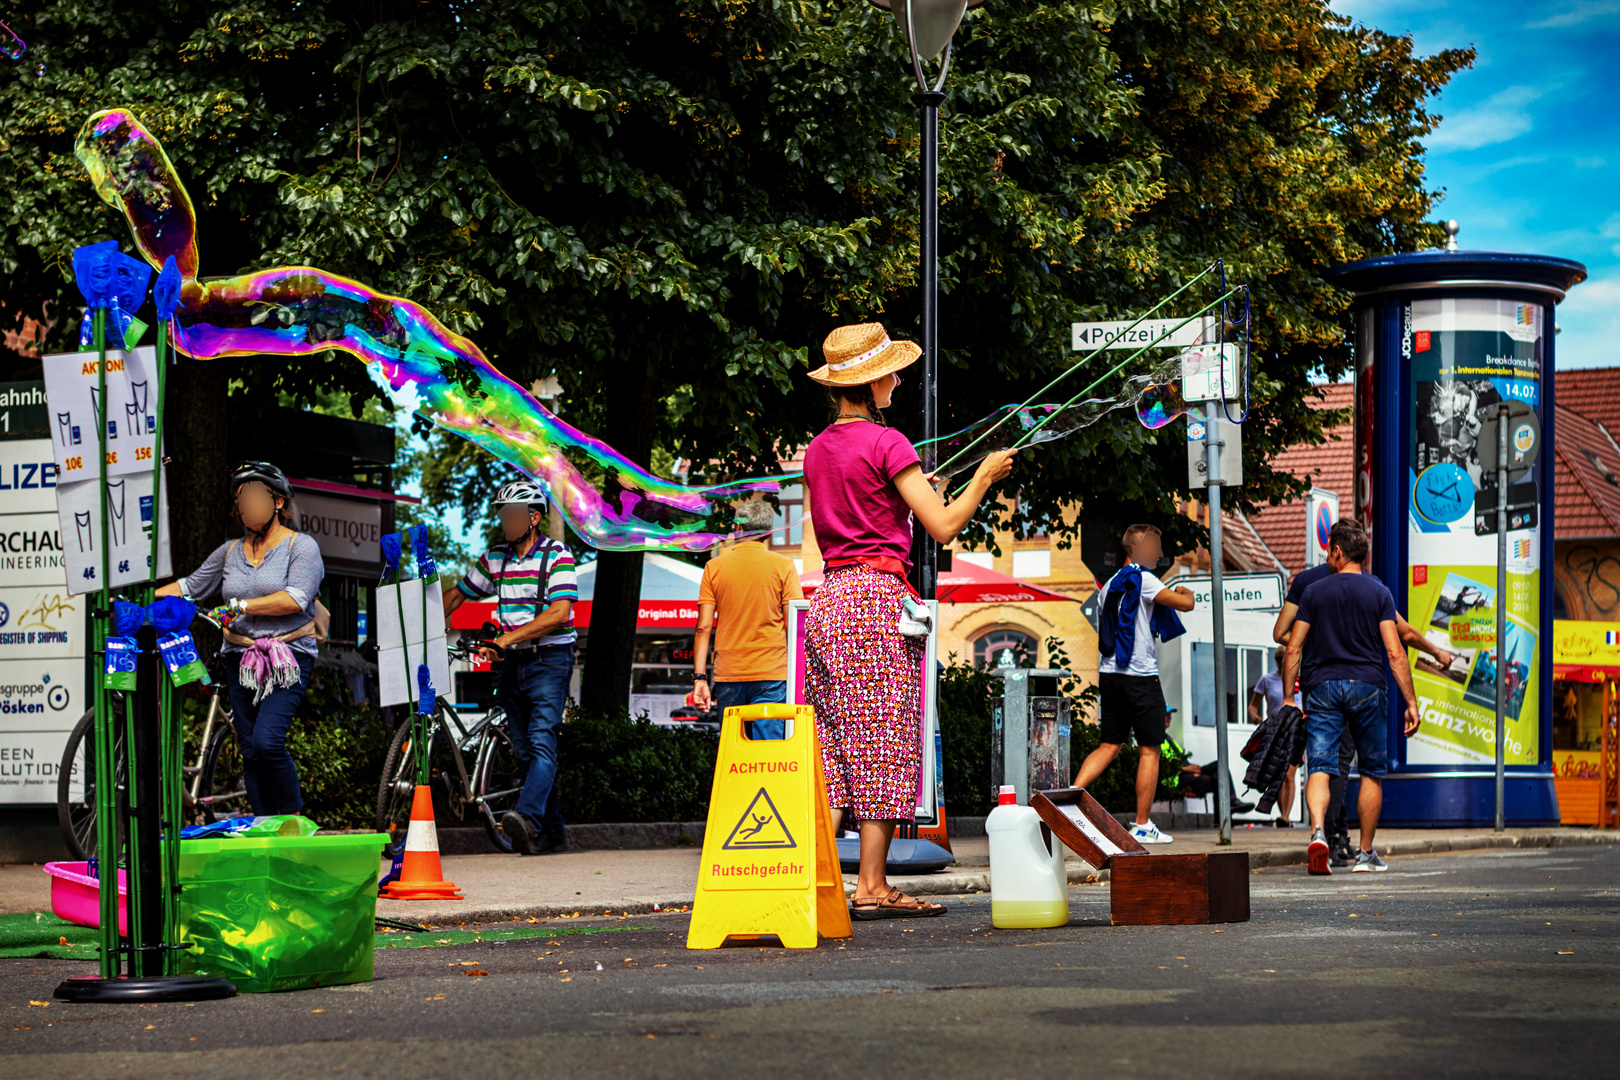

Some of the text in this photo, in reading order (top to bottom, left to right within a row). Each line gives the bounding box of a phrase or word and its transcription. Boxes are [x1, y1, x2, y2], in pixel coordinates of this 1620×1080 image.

[1092, 325, 1154, 345] Polizei
[1402, 305, 1411, 360] JCDecaux
[82, 358, 125, 376] AKTON!
[1486, 354, 1527, 367] Breakdance
[1458, 365, 1513, 376] internationalen
[1505, 383, 1537, 399] 14.07.
[106, 451, 118, 466] 2€
[135, 446, 152, 461] 15€
[65, 456, 83, 471] 10€
[301, 514, 379, 547] BOUTIQUE
[83, 566, 96, 580] 4€
[118, 559, 130, 573] 6€
[638, 608, 678, 621] Original
[28, 632, 36, 644] OF
[38, 631, 68, 644] SHIPPING
[673, 650, 694, 660] CREP
[0, 699, 44, 714] ösken
[1435, 697, 1497, 727] international
[1418, 696, 1522, 755] Tanzwohe
[1, 748, 34, 760] EEN
[729, 761, 798, 774] ACHTUNG
[712, 862, 804, 877] Rutschgefahr
